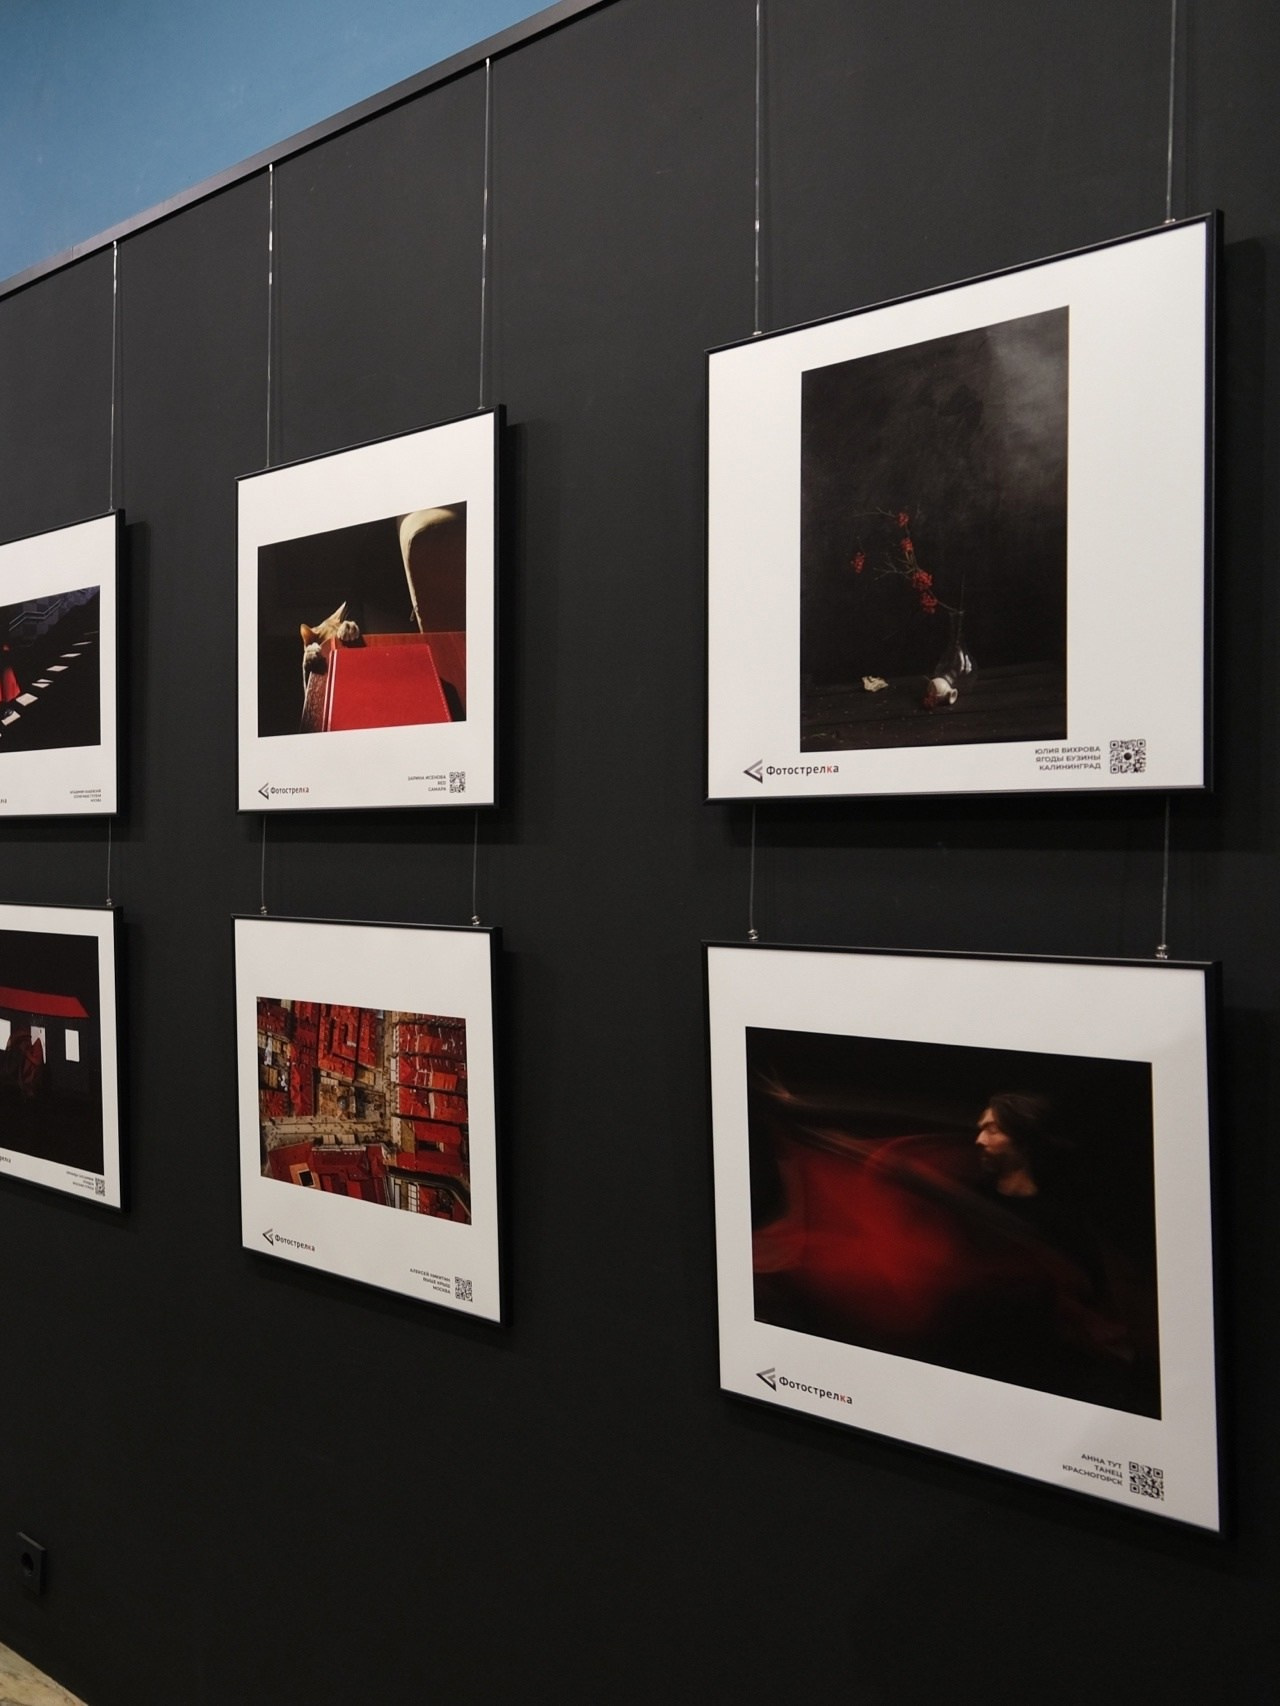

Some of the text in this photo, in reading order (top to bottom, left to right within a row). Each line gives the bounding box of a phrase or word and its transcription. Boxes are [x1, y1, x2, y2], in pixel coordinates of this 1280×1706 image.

[1035, 746, 1101, 755] ЮЛИЯ ВИХРОВА
[1036, 754, 1101, 763] ЯГОДЫ БУЗИНЫ
[766, 765, 839, 776] Фотострелка
[1039, 763, 1101, 771] КАЛИНИНГРАД
[271, 786, 309, 795] Фотострелка
[275, 1234, 315, 1251] Фотострелка
[779, 1376, 853, 1405] Фотострелка
[1081, 1453, 1122, 1469] АННА ТУТ
[1062, 1464, 1123, 1486] КРАСНОГОРСК
[1094, 1465, 1123, 1479] ТАНЕЦ
